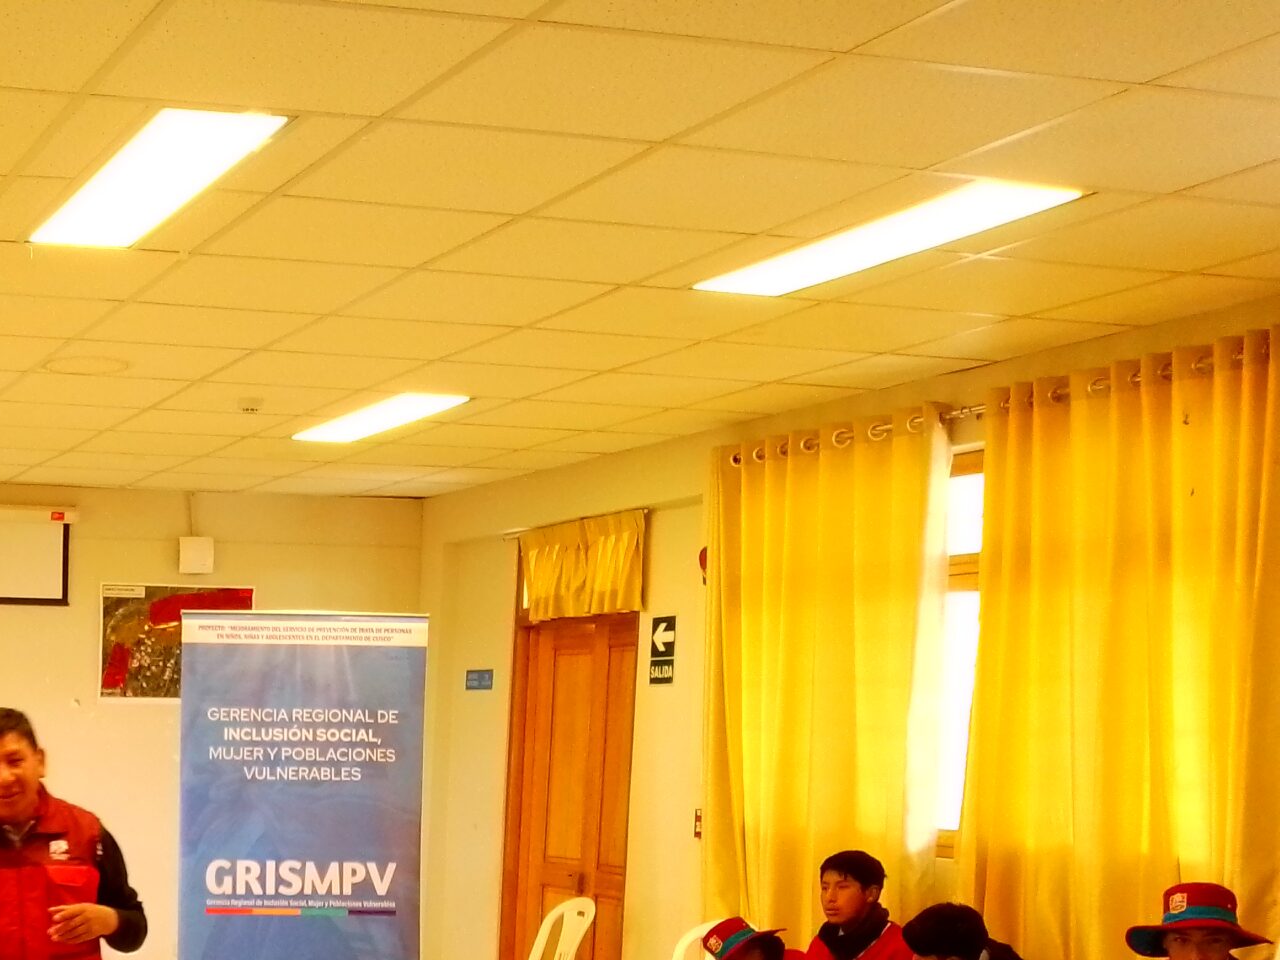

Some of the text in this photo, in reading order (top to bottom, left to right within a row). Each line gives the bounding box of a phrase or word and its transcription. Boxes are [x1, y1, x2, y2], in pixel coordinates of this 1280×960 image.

[650, 665, 673, 678] SALIDA
[207, 707, 399, 724] GERENCIA REGIONAL DE
[223, 725, 382, 745] INCLUSIÓN SOCIAL,
[209, 746, 396, 762] MUJER Y POBLACIONES
[244, 766, 361, 781] VULNERABLES
[205, 859, 397, 896] GRISMPV
